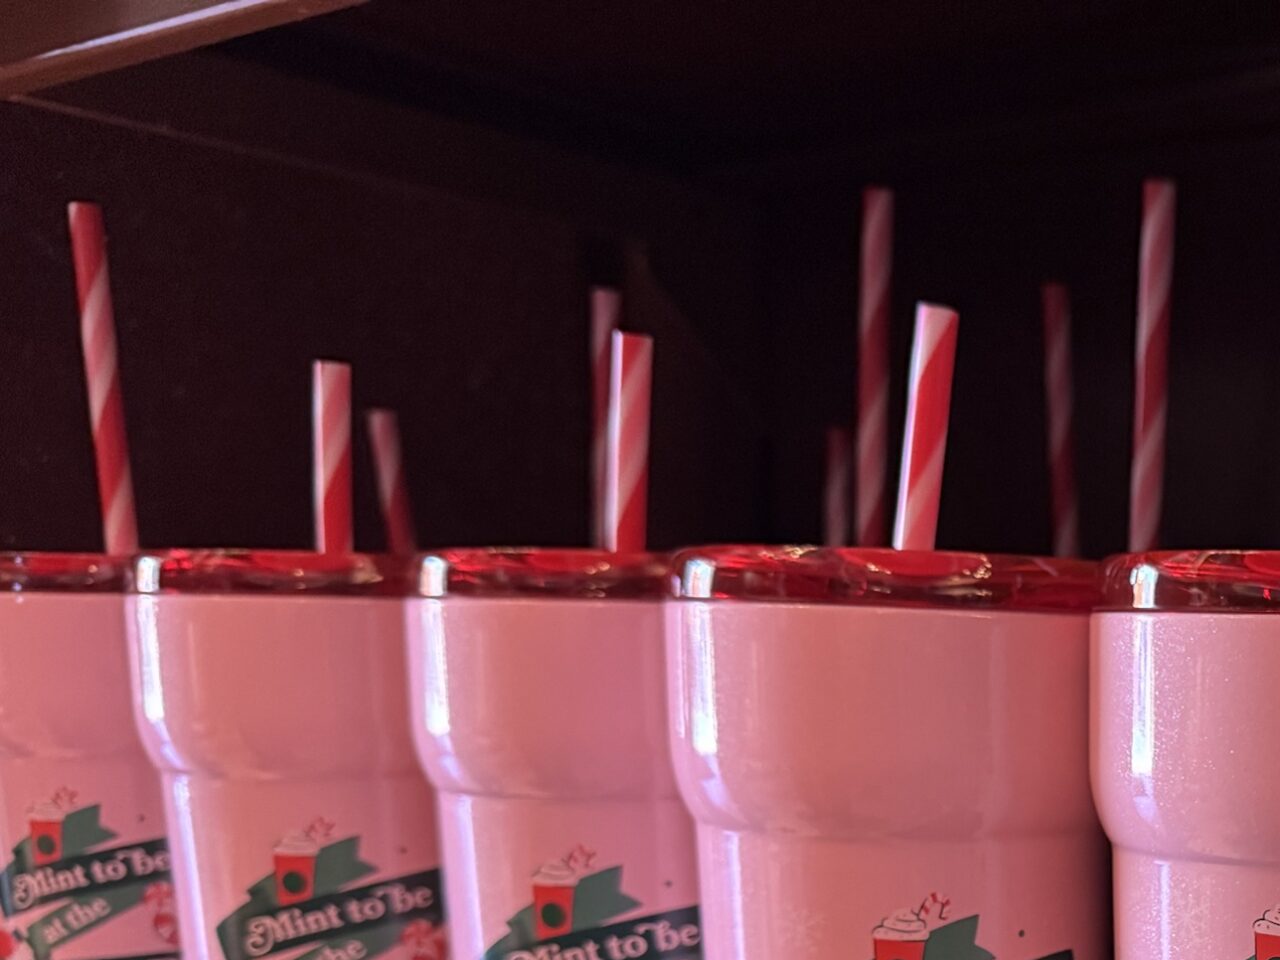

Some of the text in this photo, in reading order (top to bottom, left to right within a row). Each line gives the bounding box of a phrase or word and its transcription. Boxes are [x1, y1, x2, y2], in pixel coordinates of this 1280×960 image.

[13, 865, 89, 908] Mint
[90, 859, 126, 881] to
[42, 897, 111, 944] at the
[245, 882, 434, 957] Mint to be
[639, 920, 701, 952] be
